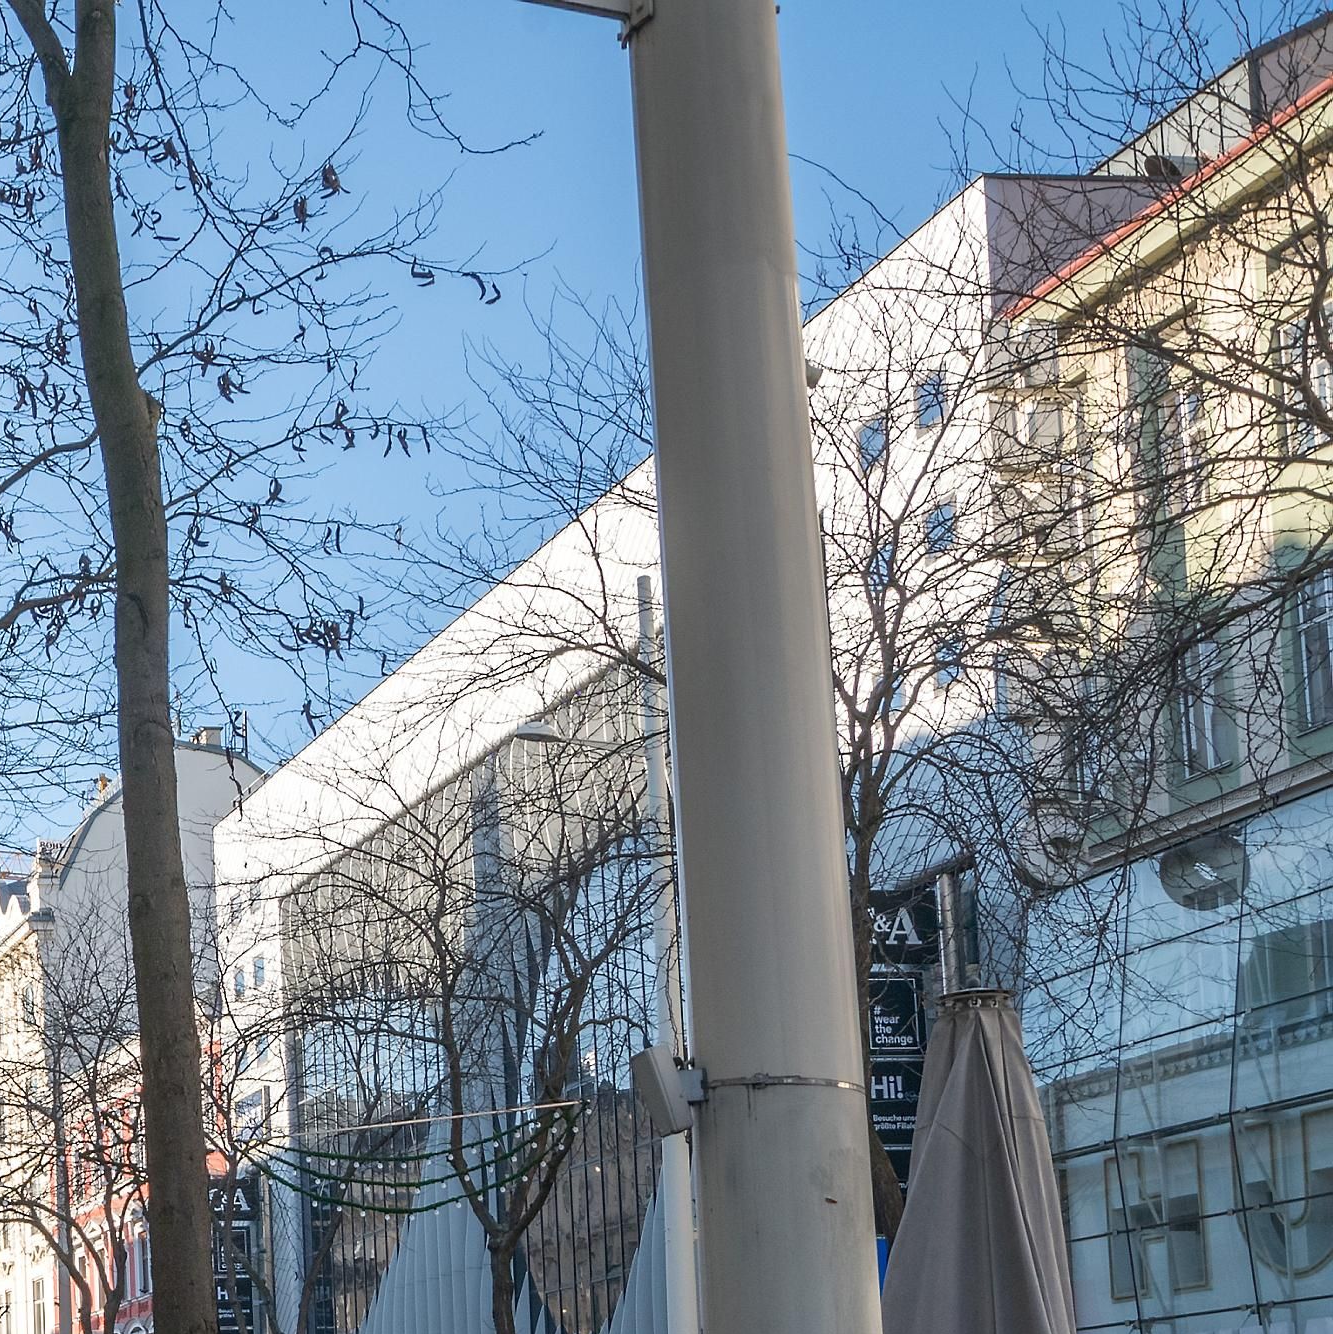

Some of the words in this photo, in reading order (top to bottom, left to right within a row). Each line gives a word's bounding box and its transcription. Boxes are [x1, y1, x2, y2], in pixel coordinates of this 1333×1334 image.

[874, 1015, 900, 1025] wear
[875, 1024, 892, 1034] the
[875, 1034, 913, 1045] change
[871, 1076, 904, 1099] Hi!
[873, 1114, 901, 1122] Besuche
